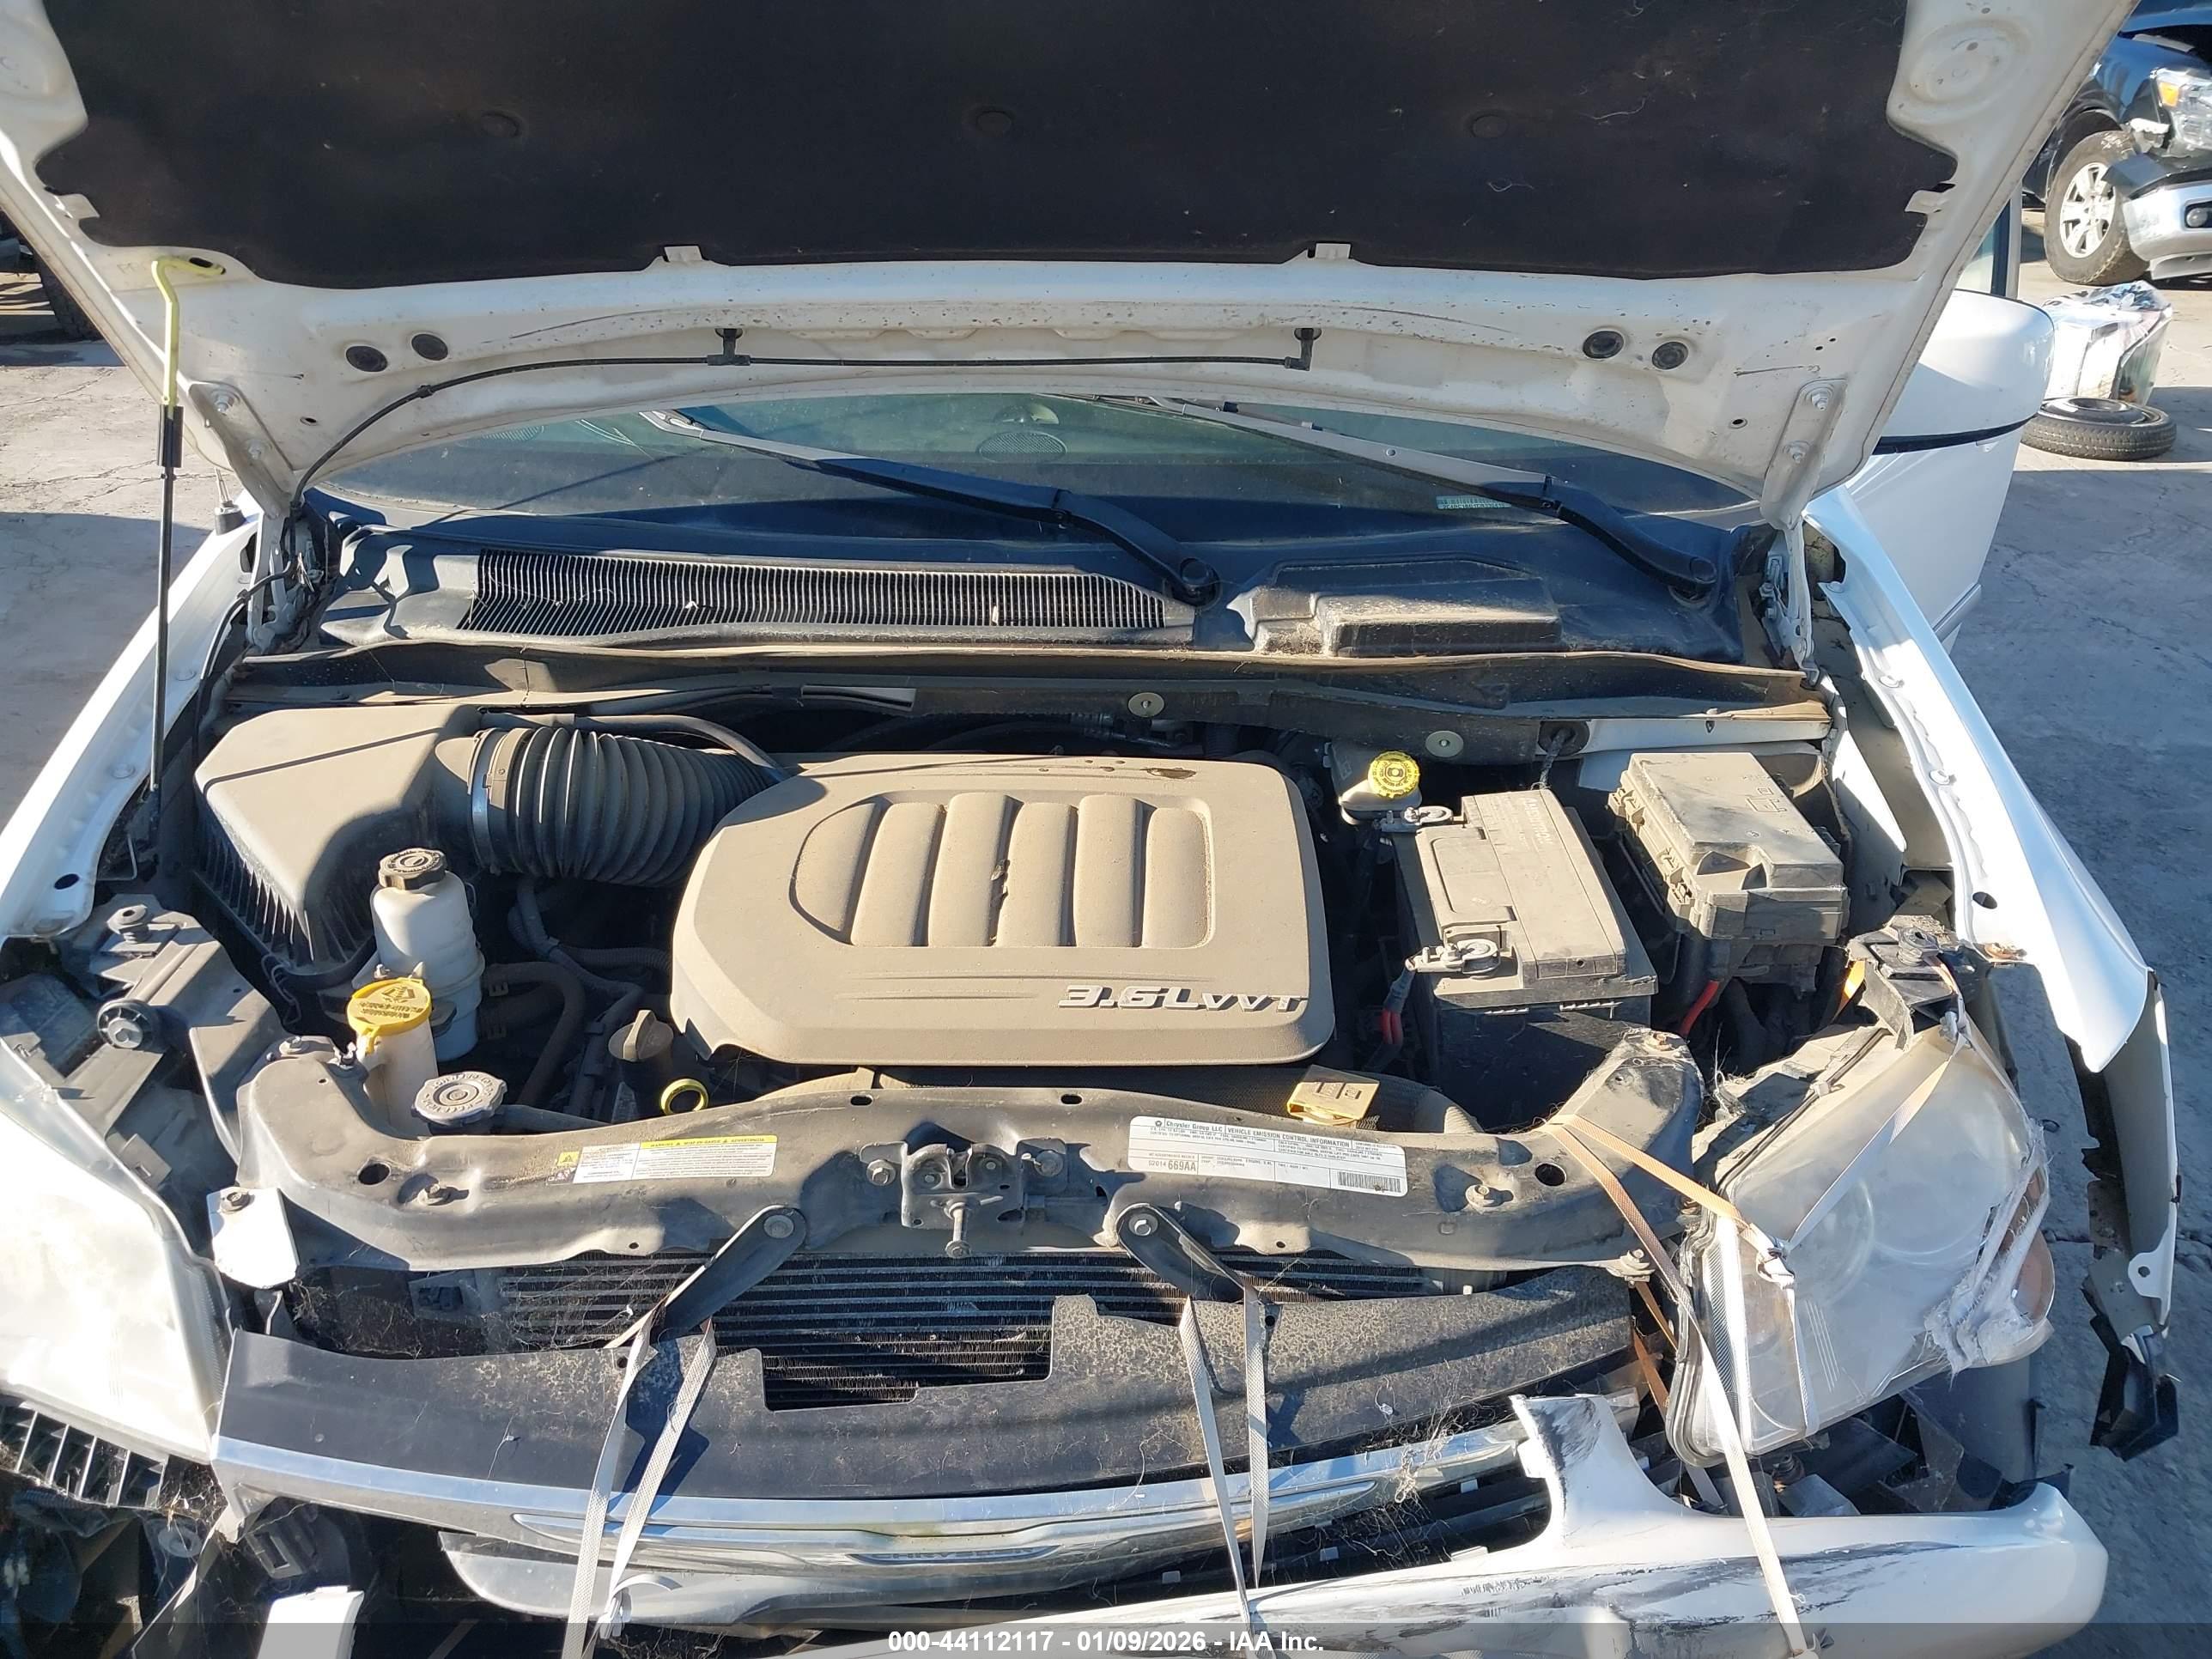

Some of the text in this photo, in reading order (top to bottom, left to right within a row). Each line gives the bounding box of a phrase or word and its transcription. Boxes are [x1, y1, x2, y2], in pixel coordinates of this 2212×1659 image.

[1166, 1121, 1190, 1129] Chrysler
[1192, 1123, 1210, 1132] Group
[1253, 1130, 1281, 1139] EMISSION
[1282, 1133, 1309, 1143] CONTROL
[1310, 1137, 1350, 1148] INFORMATION
[1168, 1160, 1196, 1171] 669AA
